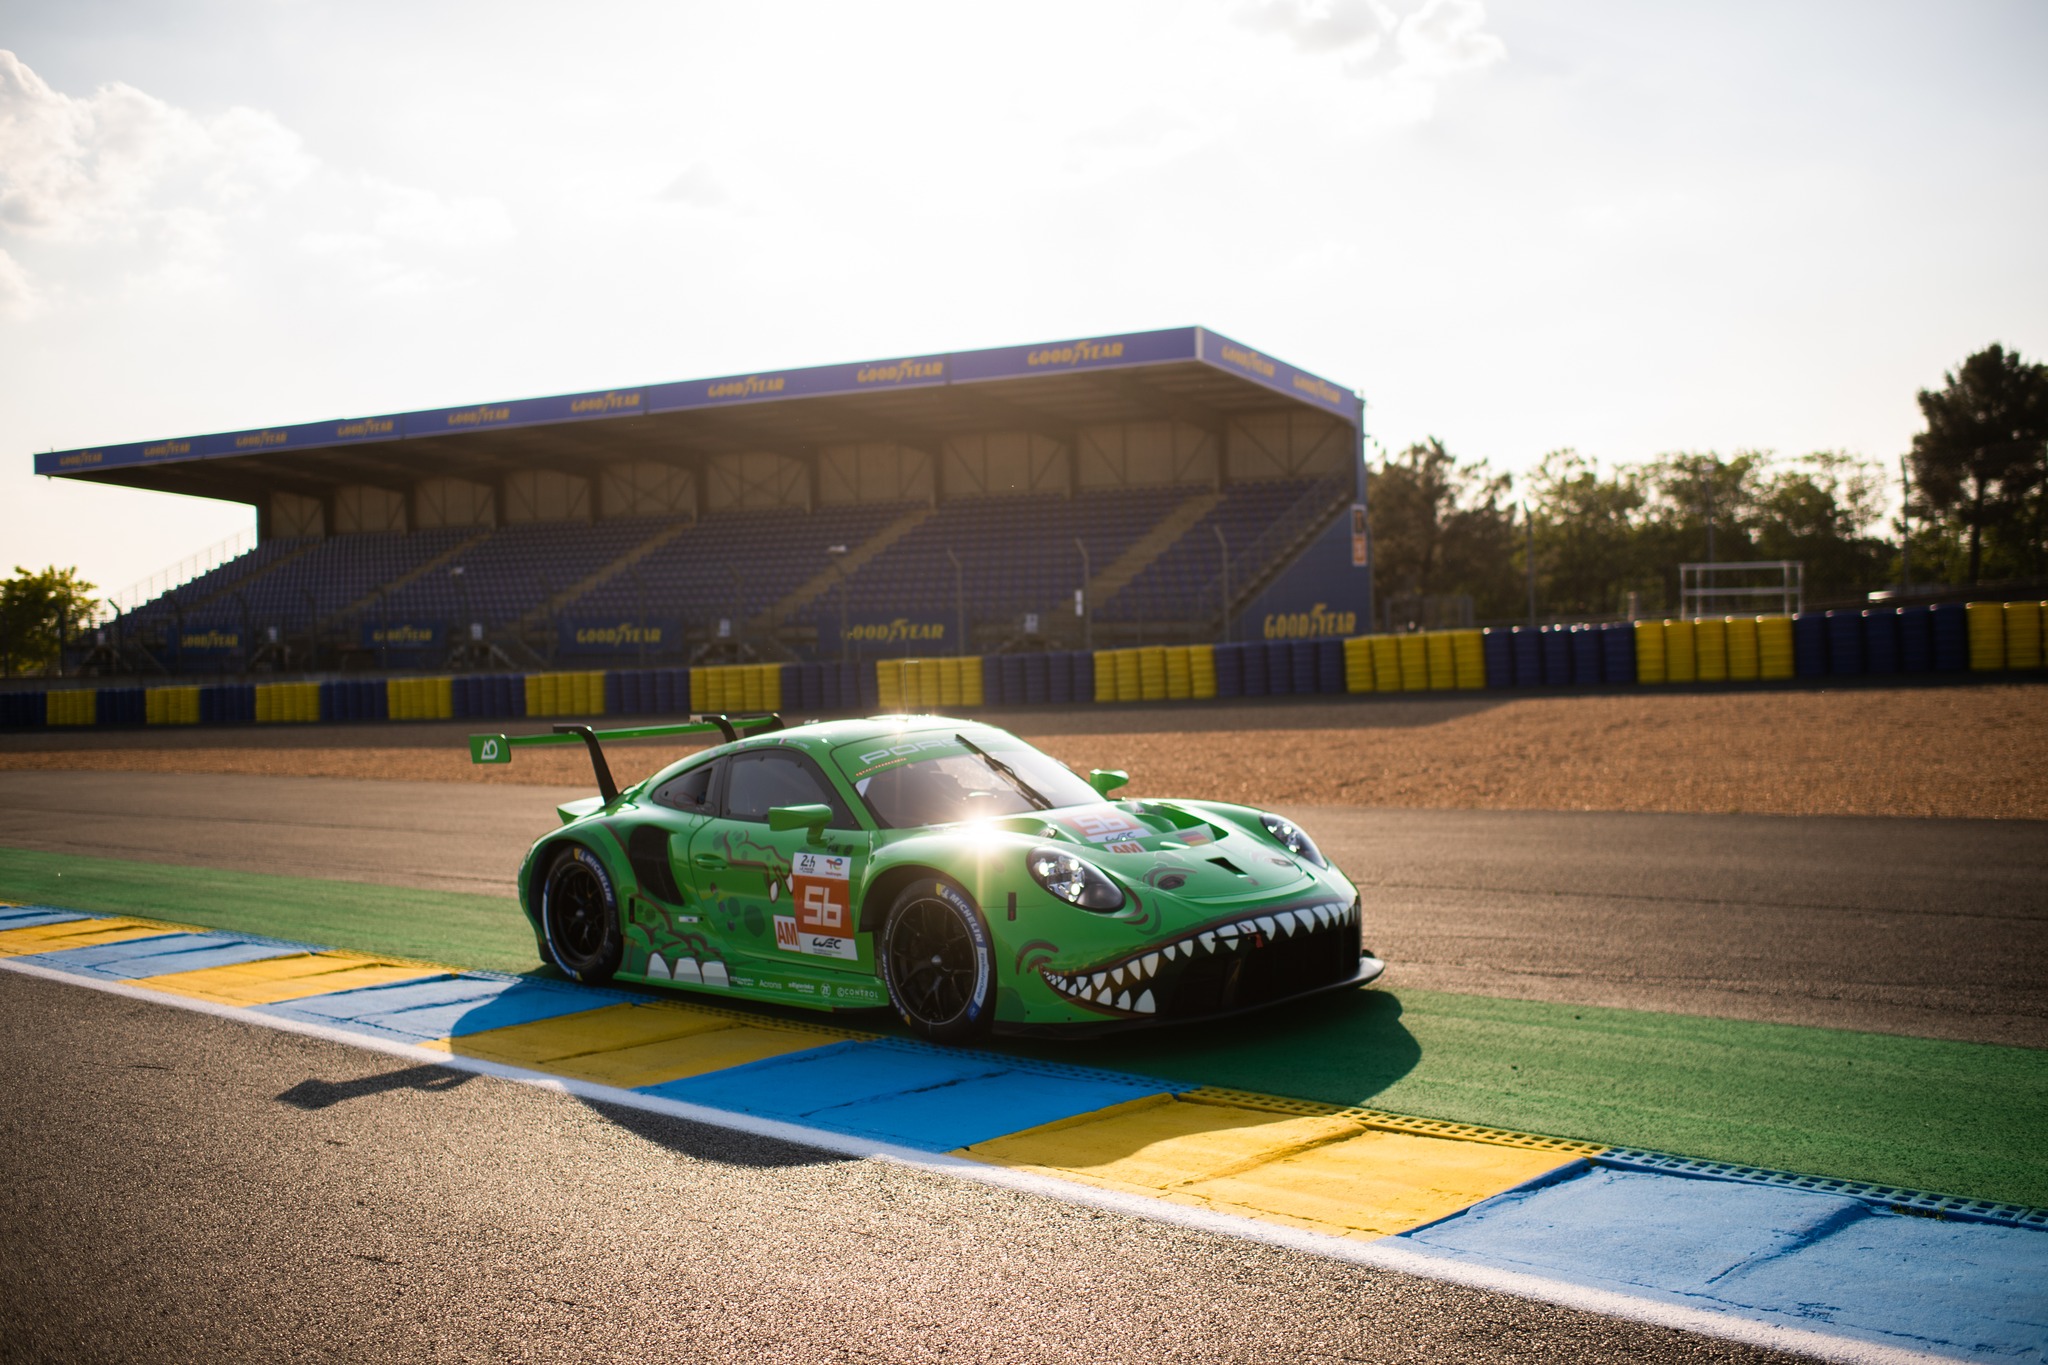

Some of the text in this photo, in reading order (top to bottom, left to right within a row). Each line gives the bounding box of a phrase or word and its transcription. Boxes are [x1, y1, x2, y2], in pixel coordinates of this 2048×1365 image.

[1027, 340, 1124, 366] GOODYEAR
[1220, 346, 1275, 378] GOODYEAR
[857, 359, 943, 383] GOODYEAR
[707, 375, 785, 398] GOODYEAR
[571, 391, 640, 413] GOODYEAR
[448, 405, 510, 426] GOODYEAR
[236, 431, 288, 448] GOODYEAR
[337, 418, 393, 438] GOODYEAR
[1264, 602, 1356, 639] GOODYEAR
[576, 622, 662, 647] GOODYEAR
[1072, 814, 1130, 834] 56
[1111, 841, 1143, 854] AM
[586, 855, 613, 902] MICHELIN
[804, 885, 842, 928] 56
[949, 894, 984, 943] MICHELIN
[777, 920, 799, 946] AM
[812, 937, 842, 950] WEC
[759, 979, 783, 990] Acronis
